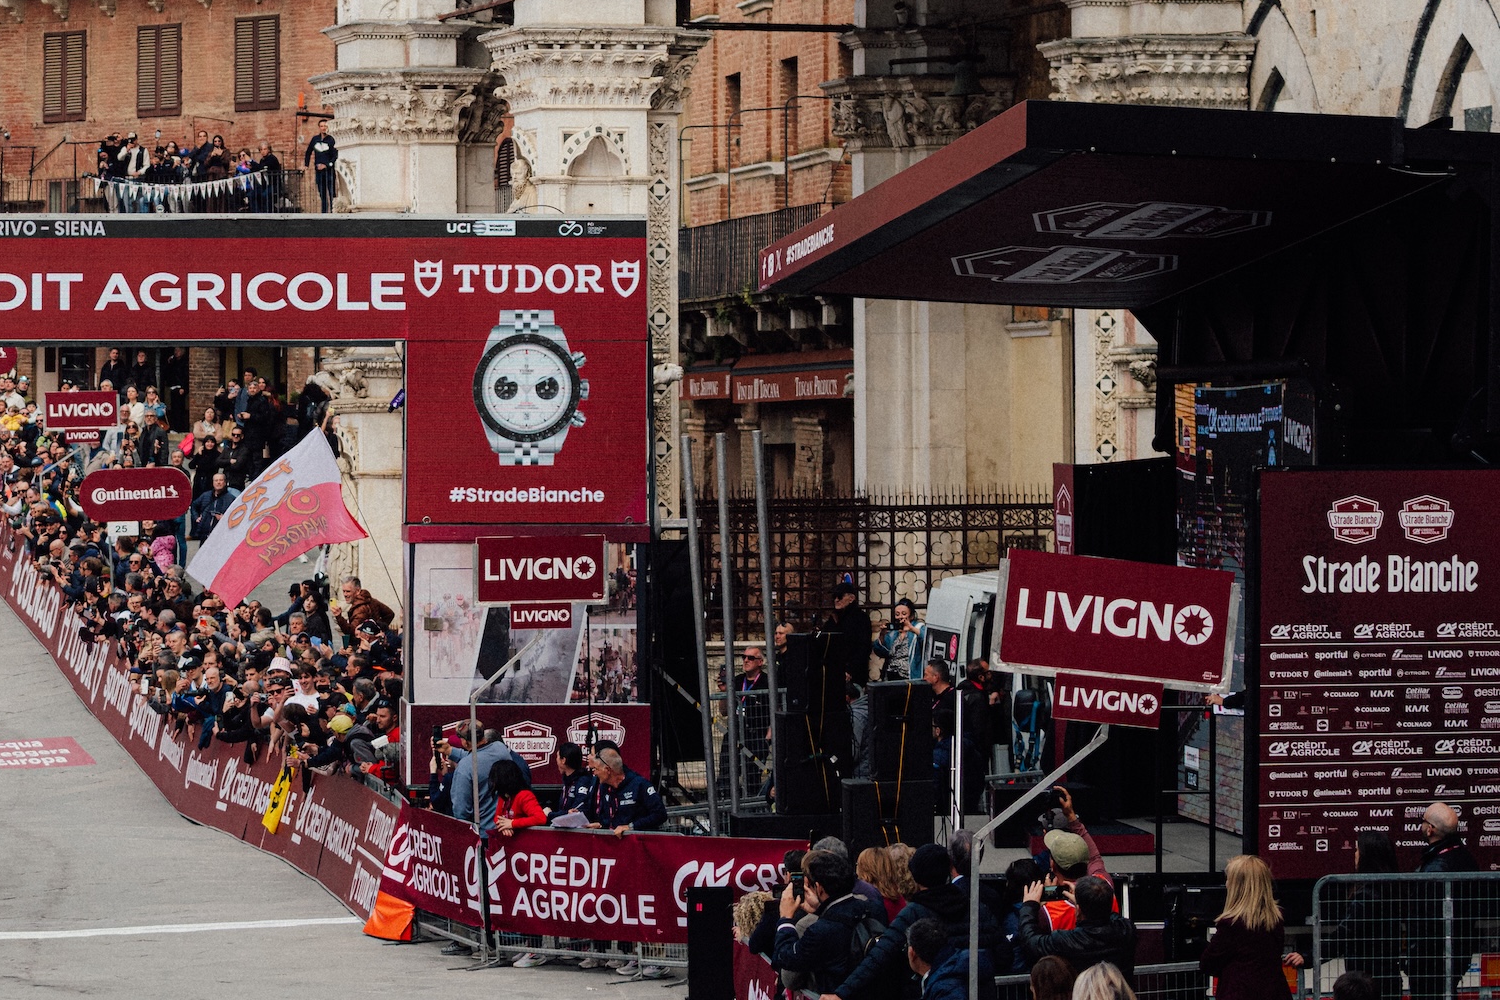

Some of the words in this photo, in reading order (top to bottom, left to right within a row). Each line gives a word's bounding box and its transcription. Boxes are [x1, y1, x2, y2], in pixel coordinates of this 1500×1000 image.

[54, 220, 106, 236] SIENA
[446, 222, 471, 233] UCI
[786, 223, 835, 265] #STRADEBIANCHE
[453, 263, 605, 294] TUDOR
[94, 272, 406, 312] AGRICOLE
[49, 401, 114, 418] LIVIGNO
[66, 430, 99, 440] LIVIGNO
[91, 486, 167, 504] Continental
[449, 486, 605, 504] #StradeBianche
[1333, 514, 1353, 525] Strade
[1354, 514, 1378, 525] Bianche
[1404, 514, 1424, 525] Strade
[1425, 513, 1448, 524] Bianche
[115, 524, 128, 533] 25
[484, 555, 597, 581] LIVIGNO
[1301, 555, 1381, 593] Strade
[1387, 554, 1479, 593] Bianche
[513, 608, 570, 623] LIVIGNO
[1015, 587, 1214, 646] LIVIGNO
[1292, 623, 1329, 632] CRÉDIT
[1375, 622, 1412, 631] CRÉDIT
[1458, 621, 1494, 630] CRÉDIT
[1292, 631, 1342, 639] AGRICOLE
[1375, 630, 1425, 638] AGRICOLE
[1458, 629, 1500, 637] AGRICOL
[1314, 650, 1348, 660] sportful
[1428, 650, 1463, 658] LIVIGNO
[1358, 668, 1392, 678] sportful
[1058, 685, 1159, 715] LIVIGNO
[526, 739, 550, 750] Bianche
[1291, 740, 1327, 749] CRÉDIT
[1374, 739, 1410, 748] CRÉDIT
[1291, 748, 1340, 756] AGRICOLE
[1374, 747, 1423, 755] AGRICOLE
[1314, 769, 1348, 779] sportful
[1427, 768, 1462, 776] LIVIGNO
[1358, 787, 1391, 797] sportful
[408, 823, 443, 863] CRÉDIT
[511, 847, 617, 889] CRÉDIT
[407, 859, 461, 905] AGRICOLE
[511, 890, 657, 926] AGRICOLE
